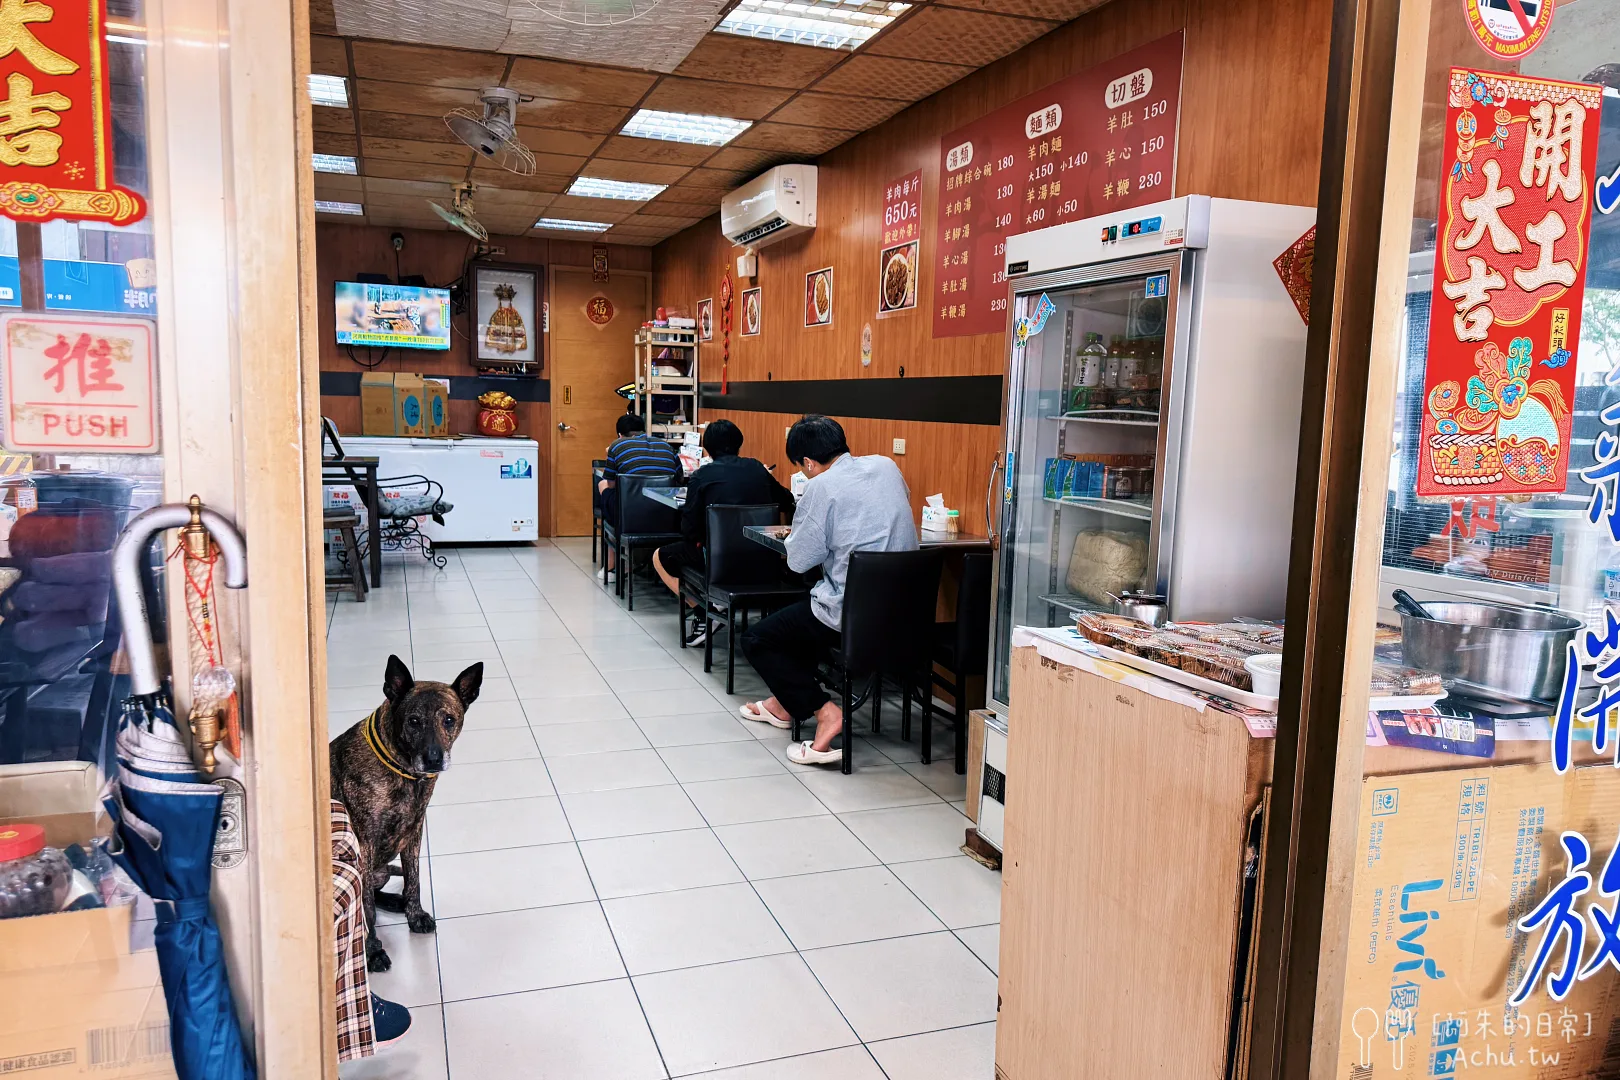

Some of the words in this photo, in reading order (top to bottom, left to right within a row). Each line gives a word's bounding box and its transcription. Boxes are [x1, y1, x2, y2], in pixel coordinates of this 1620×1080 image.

[1495, 41, 1528, 54] MAXIMUM
[1527, 26, 1543, 46] FINE:
[1111, 72, 1146, 104] 切盤
[1030, 107, 1058, 135] 麵類
[1106, 110, 1134, 134] 羊肚
[1143, 99, 1168, 121] 150
[949, 145, 970, 169] 湯類
[1027, 135, 1063, 162] 羊肉麵
[1104, 146, 1133, 168] 羊心
[1141, 135, 1165, 156] 150
[946, 162, 993, 192] 招牌綜合碗
[997, 154, 1015, 172] 180
[1102, 178, 1131, 201] 羊鞭
[1138, 171, 1163, 190] 230
[885, 175, 919, 202] 羊肉每斤
[945, 196, 972, 218] 羊肉湯
[996, 183, 1014, 200] 130
[1026, 180, 1062, 205] 羊湯麵
[1513, 96, 1587, 293] 開工
[884, 199, 918, 227] 650元
[944, 223, 971, 243] 羊腳湯
[995, 212, 1012, 229] 140
[942, 250, 969, 270] 羊心湯
[1441, 158, 1523, 344] 大吉
[941, 277, 968, 295] 羊肚湯
[593, 299, 608, 315] 福
[940, 303, 967, 320] 羊鞭湯
[991, 298, 1007, 312] 230
[1552, 312, 1566, 350] 好彩頭
[43, 332, 125, 398] 推
[43, 413, 129, 438] PUSH
[1385, 884, 1399, 941] Essentials
[1393, 878, 1447, 980] Livi
[1367, 931, 1379, 964] (PEFC)
[0, 1050, 74, 1072] 健康食品認證
